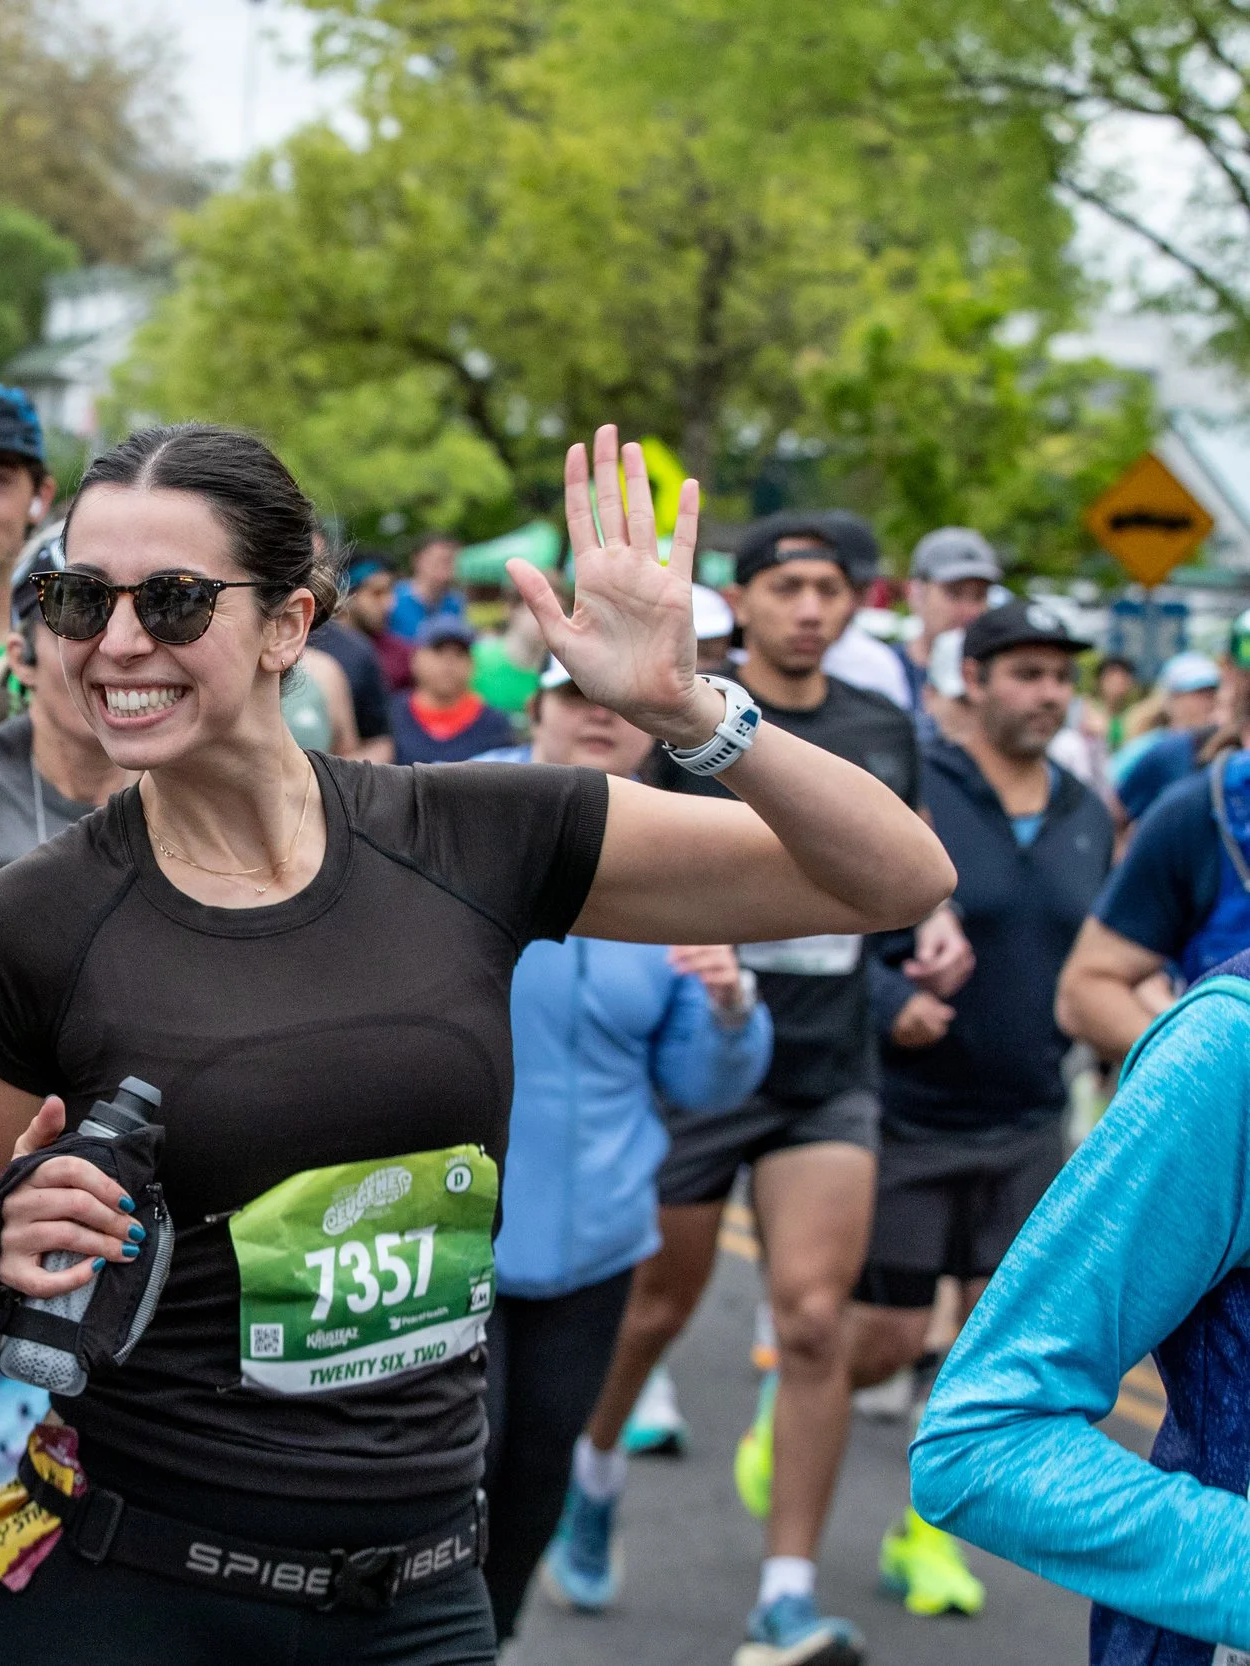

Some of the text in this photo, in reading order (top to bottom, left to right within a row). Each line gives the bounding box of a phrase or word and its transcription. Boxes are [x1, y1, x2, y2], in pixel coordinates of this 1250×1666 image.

[304, 1225, 438, 1321] 7357
[309, 1357, 377, 1386] TWENTY
[186, 1541, 333, 1595] SPIBE
